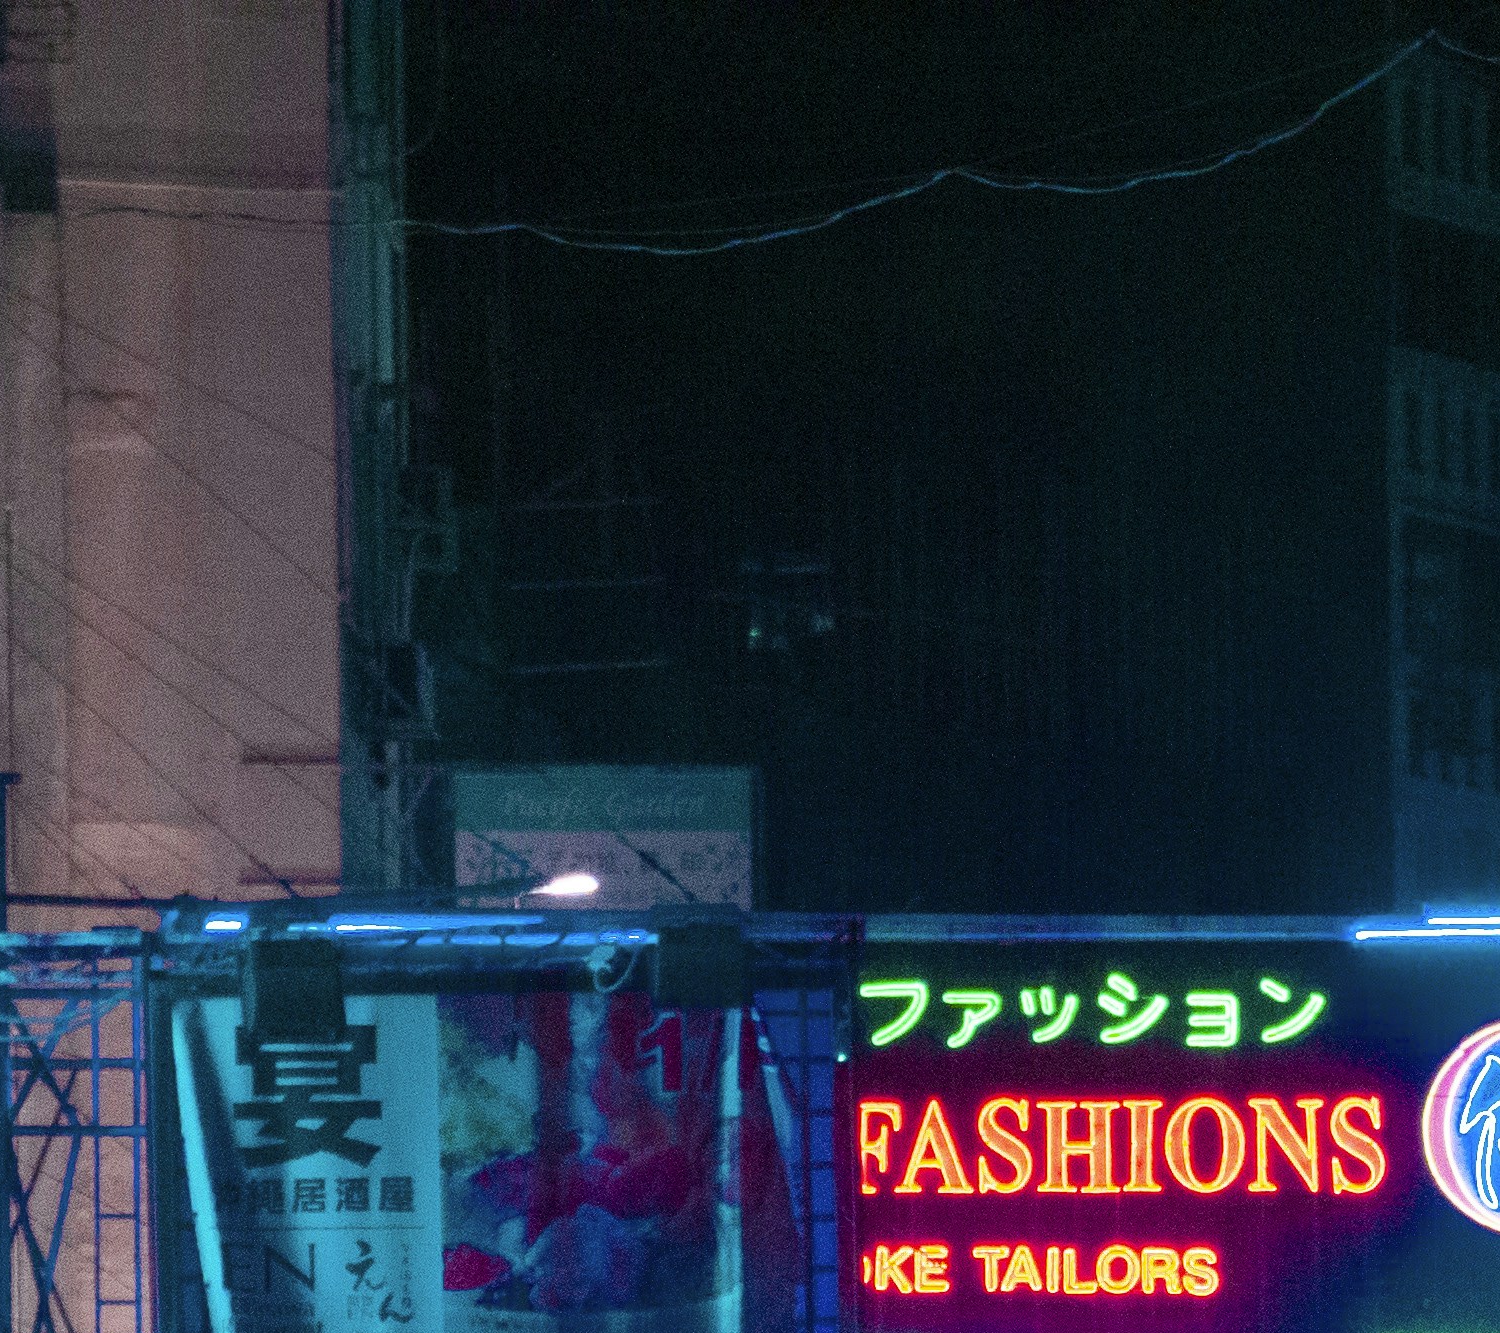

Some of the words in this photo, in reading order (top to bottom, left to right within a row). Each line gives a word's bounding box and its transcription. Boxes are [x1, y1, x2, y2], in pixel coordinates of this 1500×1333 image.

[861, 972, 1326, 1048] ファッション
[861, 1097, 1387, 1196] FASHIONS
[862, 1246, 950, 1296] KE
[973, 1246, 1219, 1296] TAILORS
